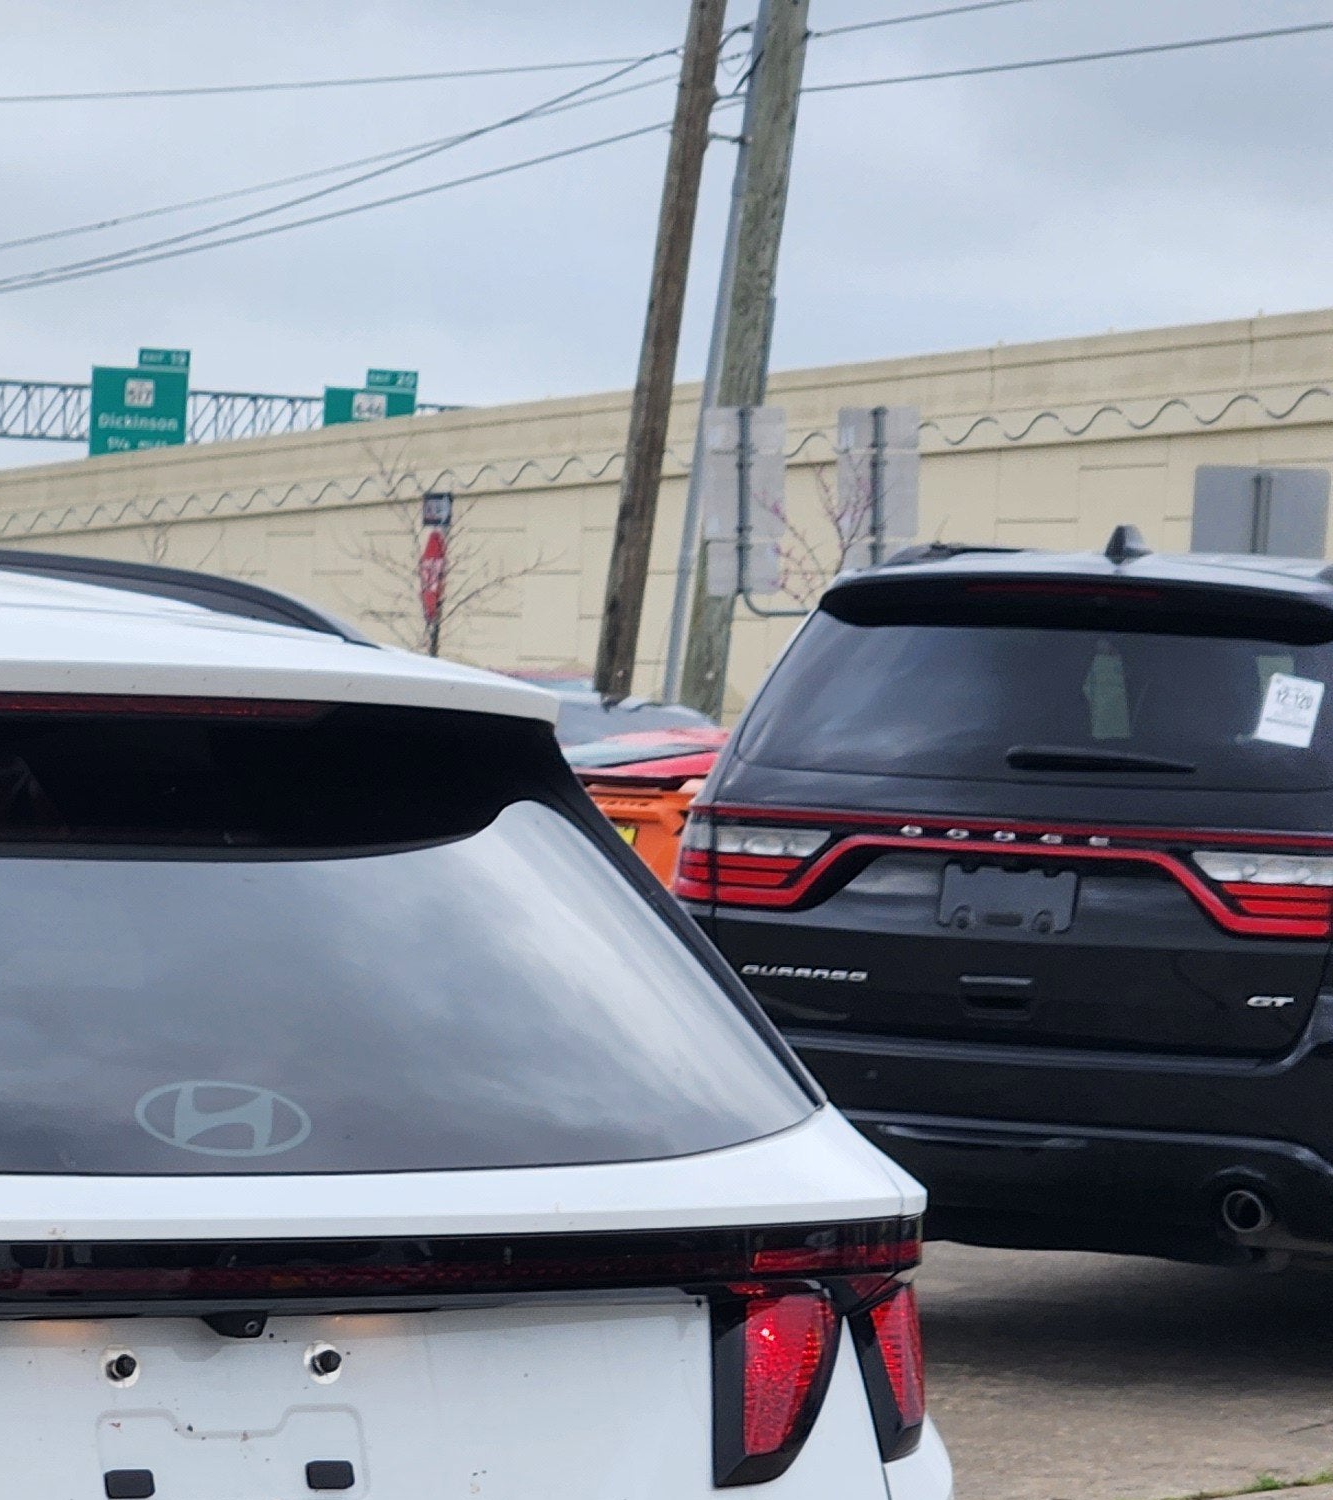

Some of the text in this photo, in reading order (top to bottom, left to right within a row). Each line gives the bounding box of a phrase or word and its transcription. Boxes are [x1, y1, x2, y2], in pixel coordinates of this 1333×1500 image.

[97, 412, 179, 432] Dickinson
[900, 824, 1110, 847] DODGE
[741, 964, 869, 983] DURANGO
[1246, 995, 1295, 1008] GT
